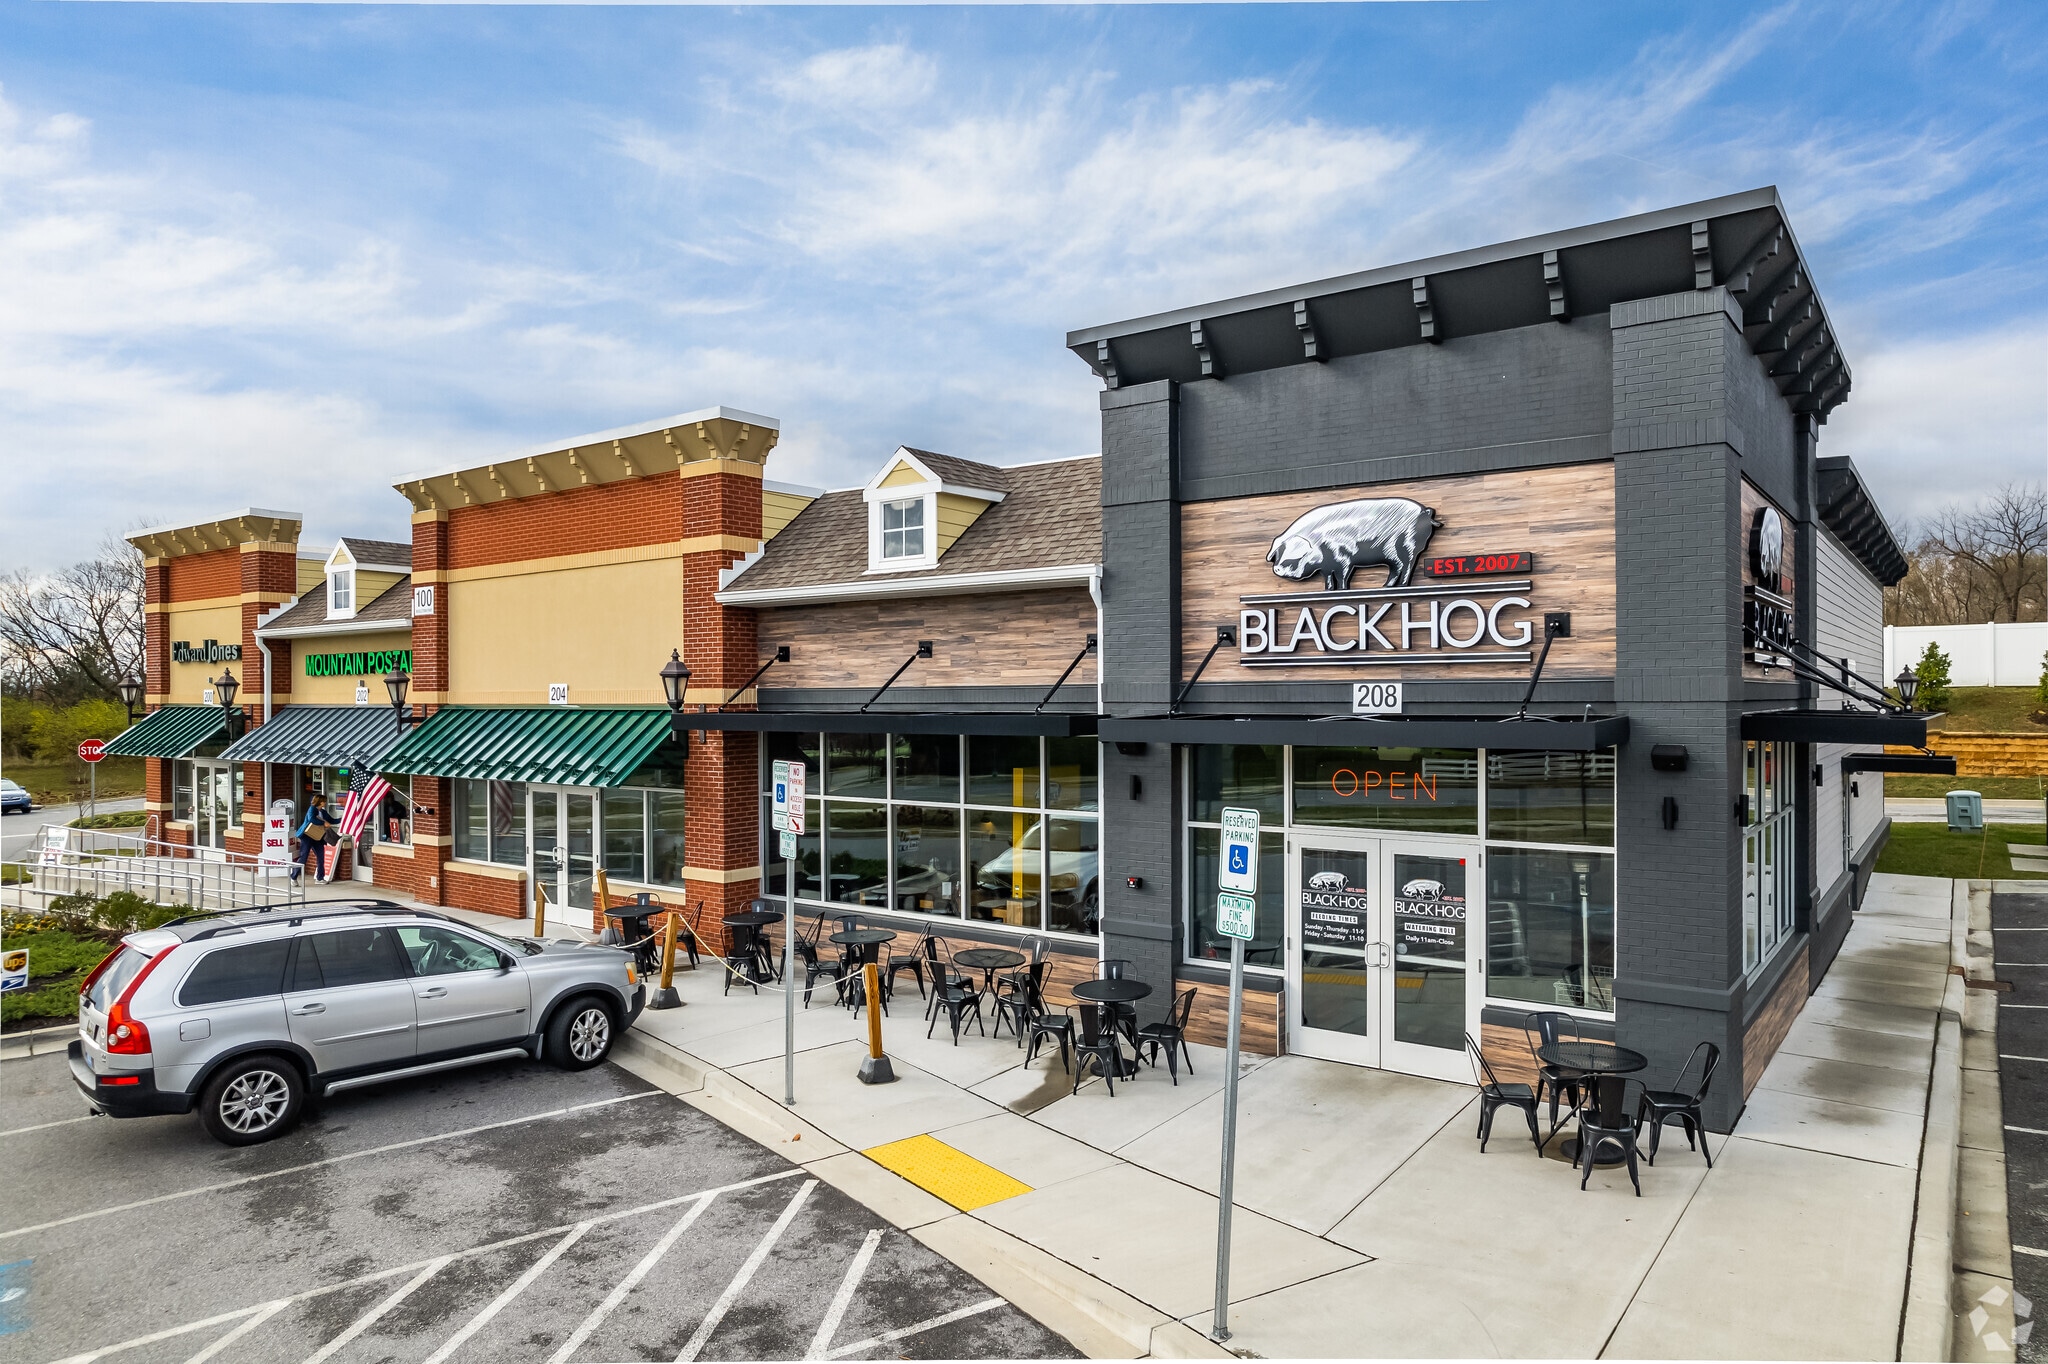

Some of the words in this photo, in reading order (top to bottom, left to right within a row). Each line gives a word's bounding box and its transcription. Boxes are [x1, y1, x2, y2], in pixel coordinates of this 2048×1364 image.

[416, 589, 433, 607] 100
[1239, 601, 1396, 654] BLACK
[1401, 596, 1534, 650] HOG
[172, 641, 206, 663] Edward
[206, 639, 239, 664] Jones
[305, 652, 364, 676] MOUNTAIN
[356, 690, 367, 702] 202
[551, 686, 566, 701] 204
[1357, 684, 1398, 708] 208
[80, 746, 104, 756] STO
[793, 767, 801, 777] NO
[790, 778, 802, 786] PARKING
[1332, 768, 1437, 801] OPEN
[270, 819, 285, 828] WE
[1224, 815, 1256, 830] RESERVED
[266, 839, 284, 847] SELL
[1225, 830, 1254, 844] PARKING
[1221, 898, 1251, 912] MAXIMUM
[1303, 893, 1338, 907] BLACK
[1339, 895, 1367, 909] HOG
[1228, 909, 1243, 922] FINE
[1395, 901, 1434, 916] BLACK
[1435, 905, 1465, 918] HOG
[1313, 913, 1336, 921] FEEDING
[1339, 915, 1357, 923] TIMES
[1221, 920, 1249, 935] $500.00
[1405, 923, 1437, 932] WATERING
[1439, 926, 1454, 934] HOLE
[1405, 935, 1420, 943] Daily
[4, 957, 26, 969] ups
